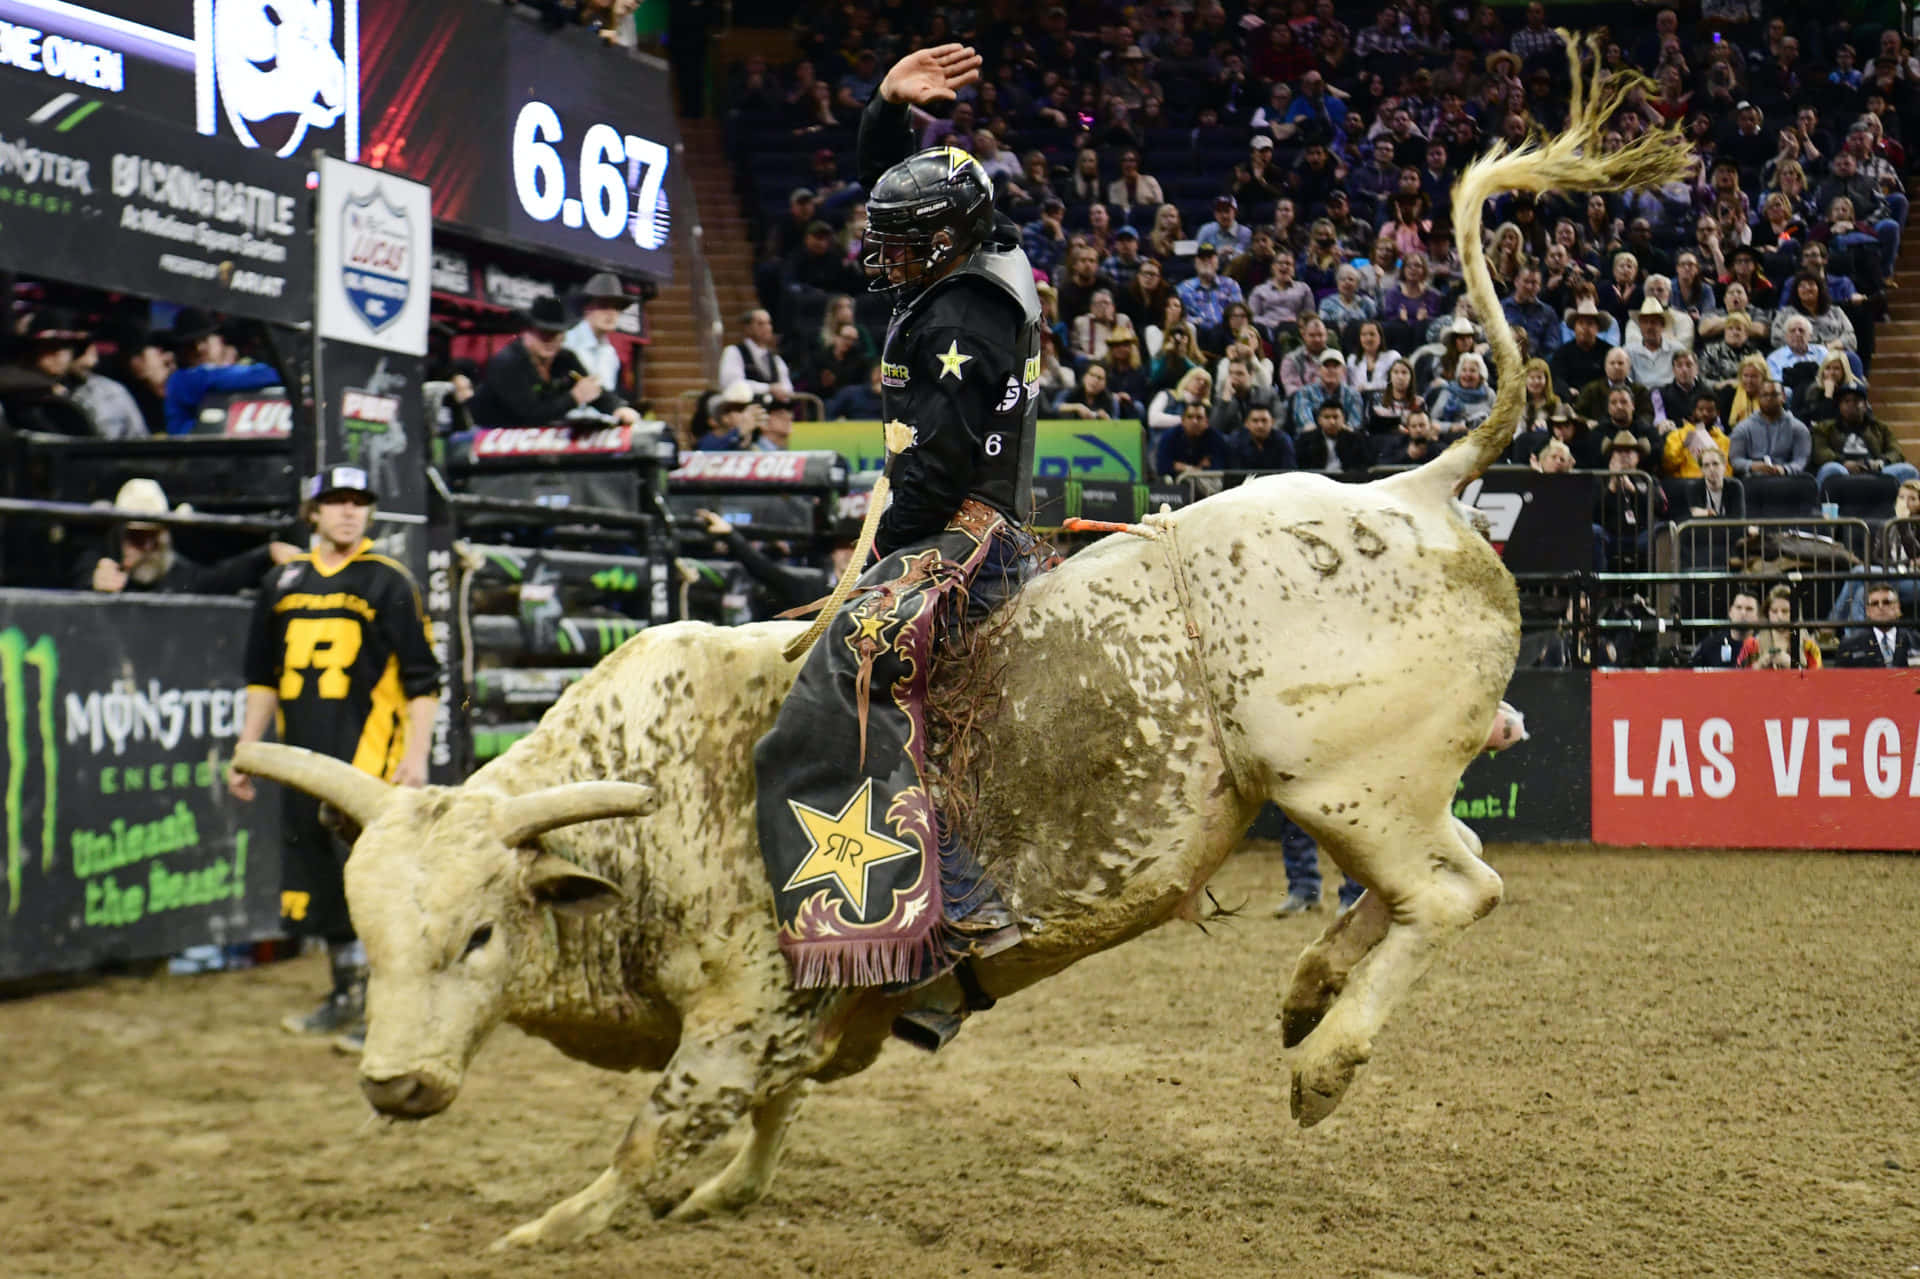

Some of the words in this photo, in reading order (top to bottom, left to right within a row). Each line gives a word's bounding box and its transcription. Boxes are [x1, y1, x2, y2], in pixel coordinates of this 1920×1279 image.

[513, 101, 665, 249] 6.67
[756, 456, 799, 478] OIL
[985, 433, 1003, 456] 6
[1613, 717, 1736, 799] LAS
[1764, 717, 1920, 799] VEG
